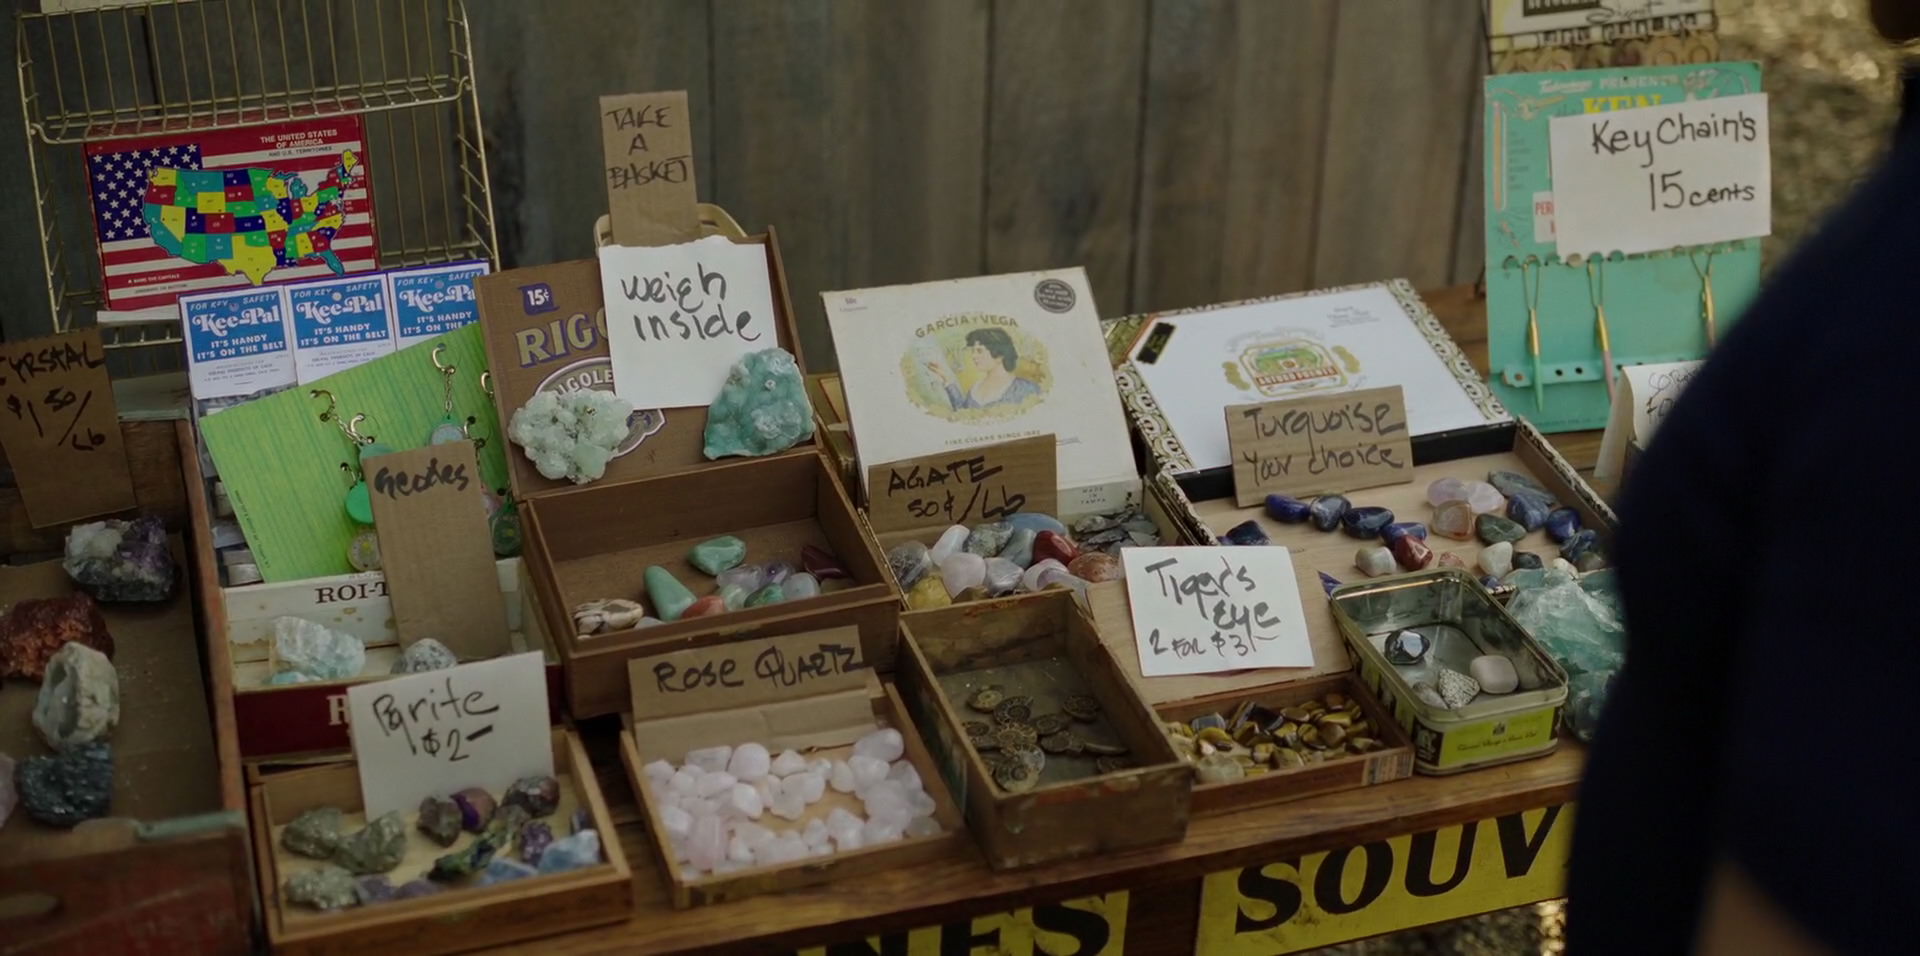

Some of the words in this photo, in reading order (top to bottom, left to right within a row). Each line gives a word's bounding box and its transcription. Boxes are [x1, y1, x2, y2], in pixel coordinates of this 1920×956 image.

[604, 104, 672, 131] TAKE
[260, 135, 276, 143] THE
[277, 131, 305, 142] UNITED
[307, 129, 338, 140] STATES
[276, 141, 289, 149] OF
[291, 138, 325, 148] AMERICA
[628, 133, 649, 155] A
[608, 154, 692, 189] BASKET
[397, 278, 415, 287] FOR
[448, 271, 481, 281] SAFETY
[293, 290, 312, 299] FOR
[314, 288, 333, 297] KEY
[345, 282, 380, 293] SAFETY
[399, 284, 476, 313] Kee-Pa
[527, 288, 549, 306] 15¢
[190, 302, 208, 312] FOR
[242, 294, 277, 305] SAFETY
[416, 315, 434, 324] IT'S
[437, 311, 472, 322] HANDY
[980, 314, 1020, 327] VEGA
[300, 337, 319, 346] IT'S
[323, 335, 339, 344] ON
[343, 331, 361, 341] THE
[365, 329, 387, 339] BELT
[314, 326, 333, 336] IT'S
[335, 323, 371, 333] HANDY
[402, 326, 421, 335] IT'S
[425, 323, 441, 332] ON
[196, 350, 216, 360] IT'S
[219, 347, 237, 357] ON
[240, 344, 258, 354] THE
[262, 340, 284, 351] BELT
[211, 339, 230, 349] IT'S
[231, 333, 267, 346] HANDY
[555, 369, 613, 397] IGOLE
[1243, 402, 1406, 459] Turquoise
[1308, 442, 1404, 475] choice
[374, 457, 470, 500] Geodes
[888, 455, 1003, 498] AGATE
[1145, 555, 1257, 620] Tiger's
[1149, 628, 1168, 656] 2
[755, 643, 873, 688] QUARTZ
[372, 677, 500, 755] Pyrite
[1235, 805, 1564, 934] SOUV
